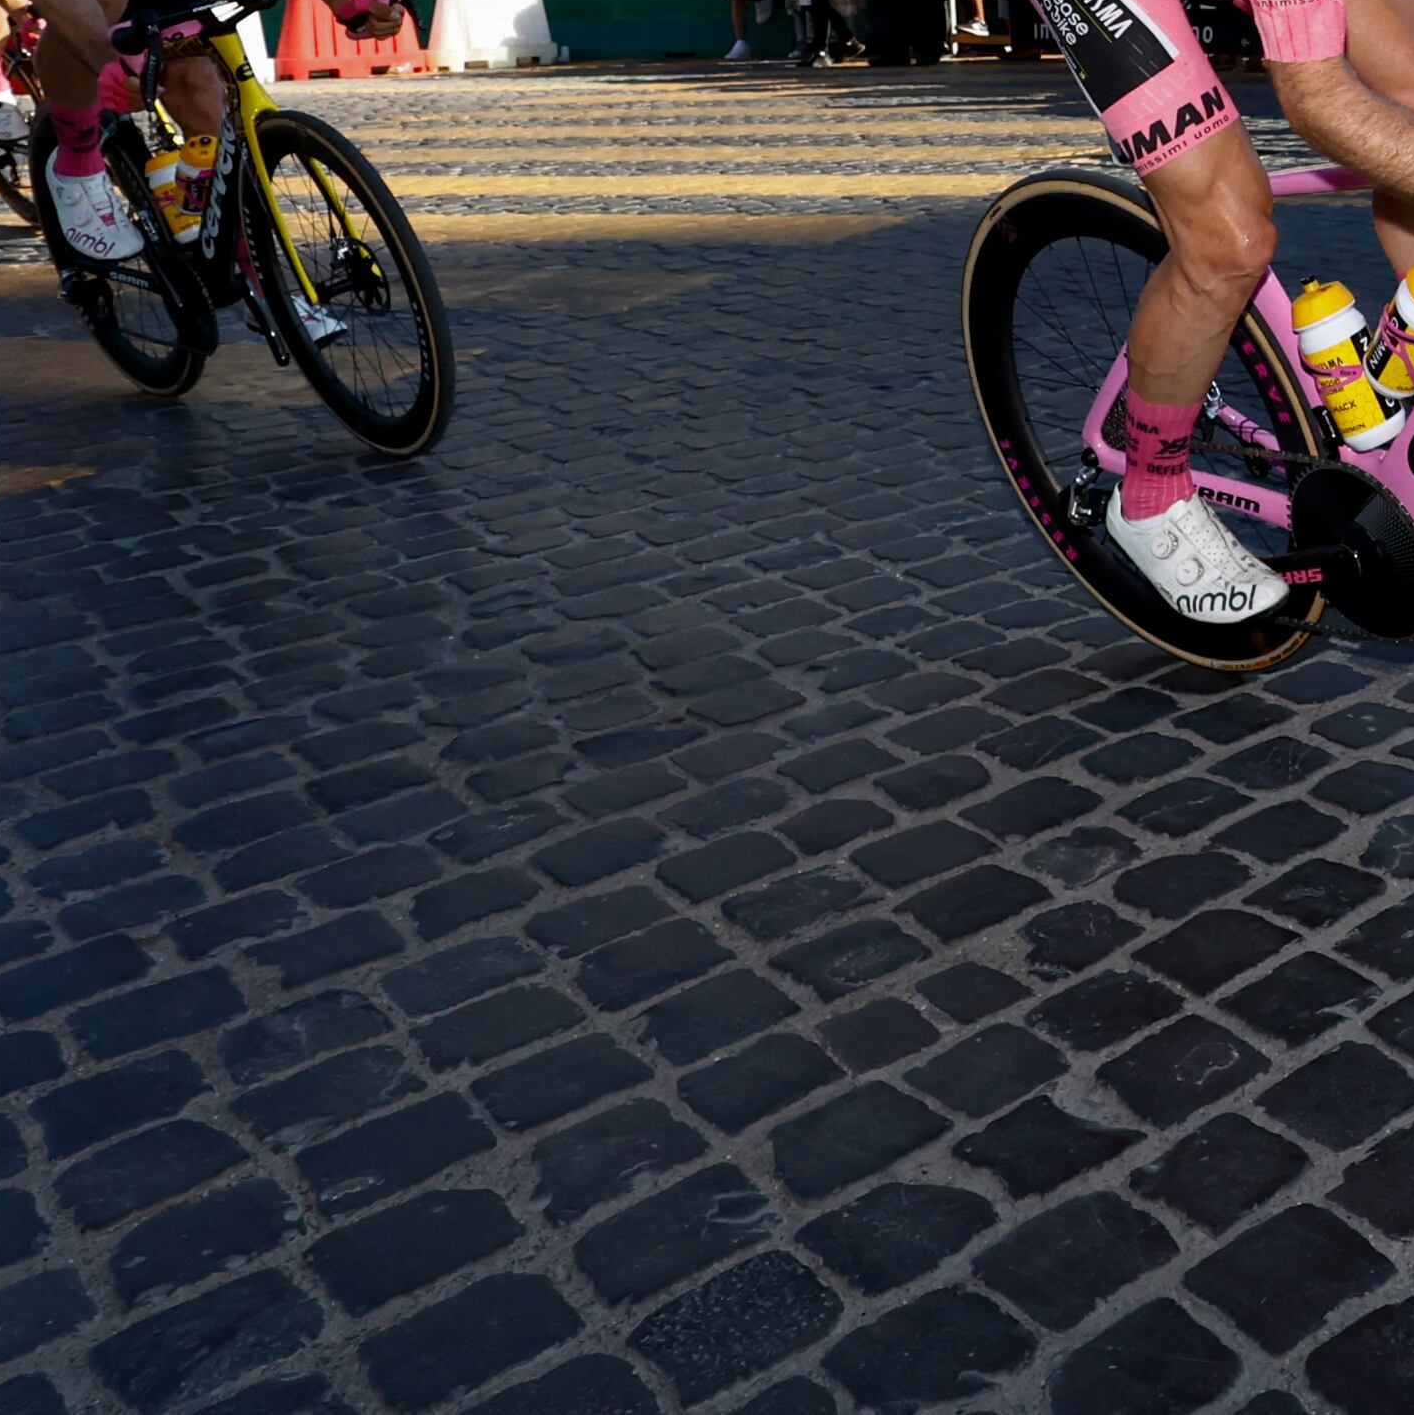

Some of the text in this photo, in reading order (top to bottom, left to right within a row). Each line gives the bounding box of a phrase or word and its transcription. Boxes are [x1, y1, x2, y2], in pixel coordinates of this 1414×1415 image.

[64, 227, 117, 258] nimbl
[998, 438, 1079, 562] RESERVE
[1193, 486, 1261, 514] RAM
[1175, 584, 1257, 614] nimbl
